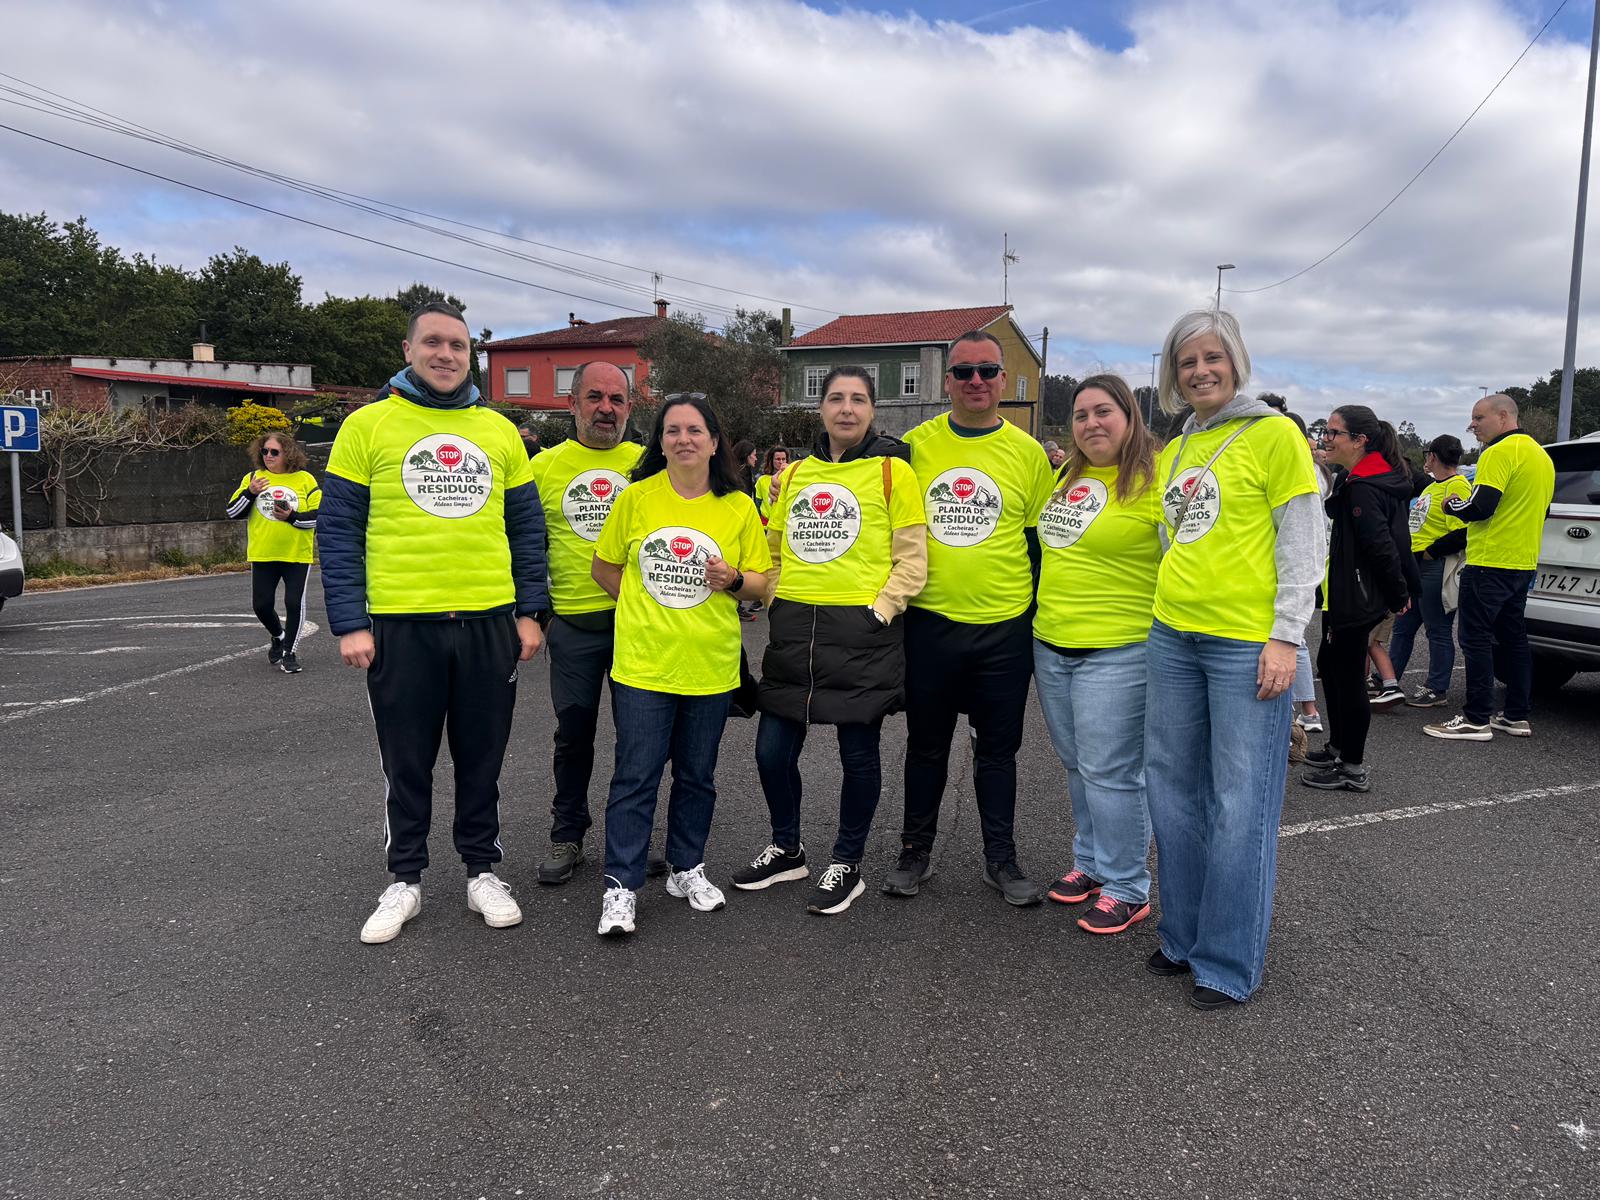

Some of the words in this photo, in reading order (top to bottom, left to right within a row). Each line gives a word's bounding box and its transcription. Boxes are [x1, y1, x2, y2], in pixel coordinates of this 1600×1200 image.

[4, 410, 25, 446] P
[440, 451, 459, 459] STOP
[424, 475, 463, 483] PLANTA
[465, 475, 478, 483] DE
[417, 484, 484, 495] RESIDUOS
[593, 483, 610, 491] STOP
[955, 483, 973, 491] STOP
[814, 498, 831, 506] STOP
[579, 504, 611, 512] PLANTA
[938, 506, 972, 514] PLANTA
[574, 512, 609, 522] RESID
[932, 514, 990, 525] RESIDUOS
[1039, 512, 1083, 529] RESIDUOS
[797, 521, 829, 529] PLANTA
[831, 521, 843, 529] DE
[792, 530, 849, 540] RESIDUOS
[1569, 528, 1586, 537] KIA
[673, 541, 691, 550] STOP
[654, 563, 690, 574] PLANTA
[692, 567, 704, 576] DE
[1540, 573, 1581, 592] 1747
[1585, 578, 1600, 594] J
